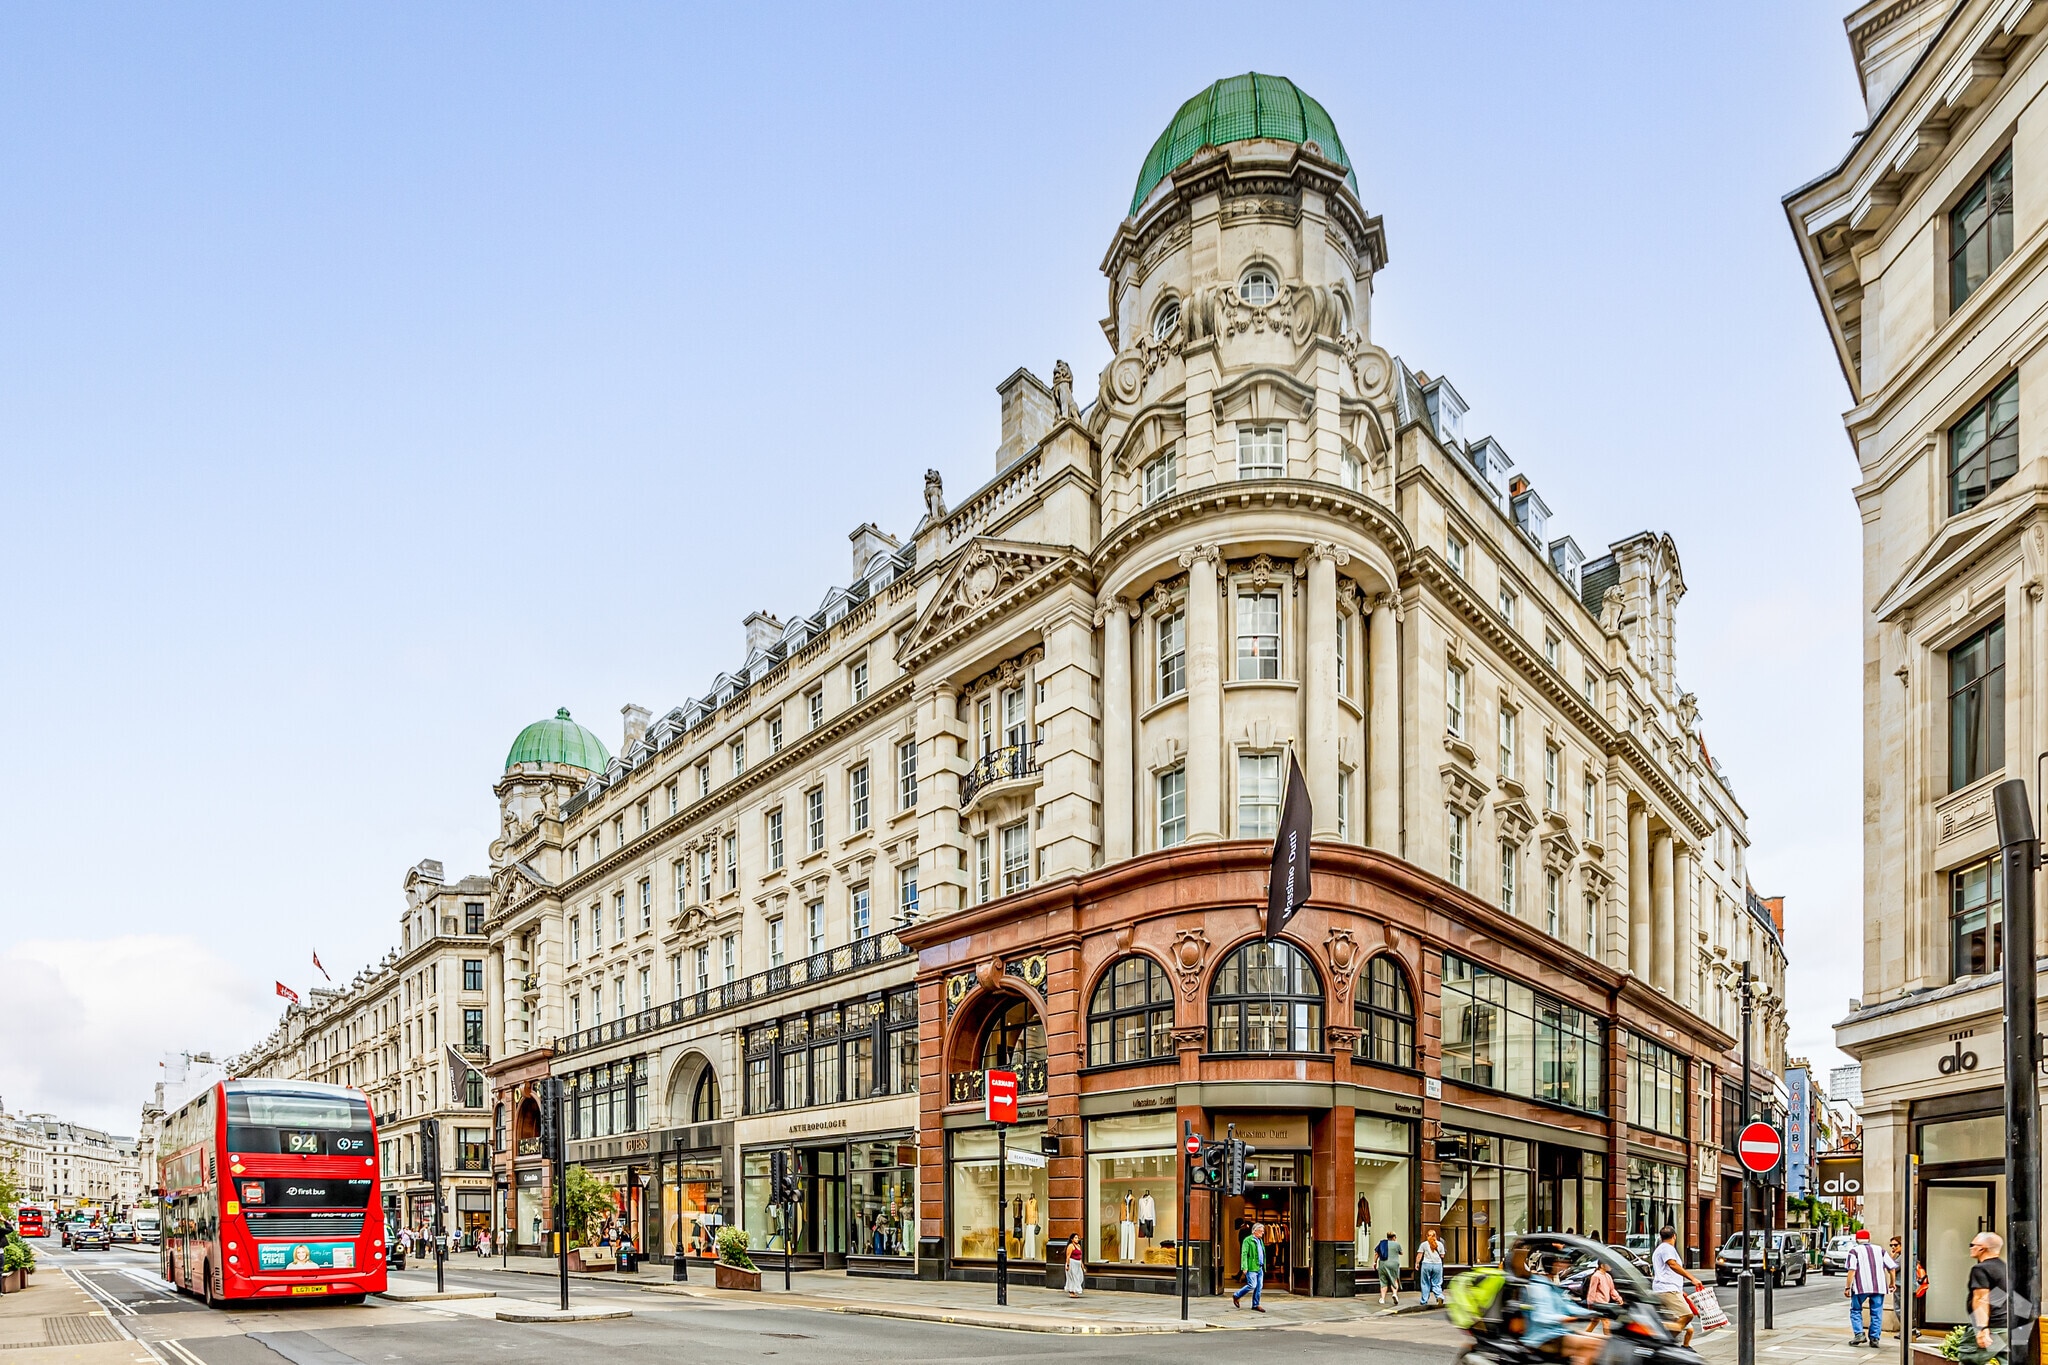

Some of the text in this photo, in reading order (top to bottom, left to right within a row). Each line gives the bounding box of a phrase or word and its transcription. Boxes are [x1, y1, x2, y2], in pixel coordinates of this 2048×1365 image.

[1282, 830, 1297, 919] Massimo Dutti
[1938, 1041, 1978, 1075] alo
[991, 1079, 1014, 1088] CARNABY
[1132, 1098, 1157, 1108] Massimo
[1791, 1081, 1800, 1153] CARNABY
[788, 1119, 847, 1133] ANTHROPOLOGIE
[1235, 1129, 1288, 1139] Massimo Dutti
[291, 1135, 314, 1151] 94
[626, 1138, 649, 1152] GUESS
[1025, 1155, 1039, 1163] STREET
[1823, 1172, 1860, 1193] alo
